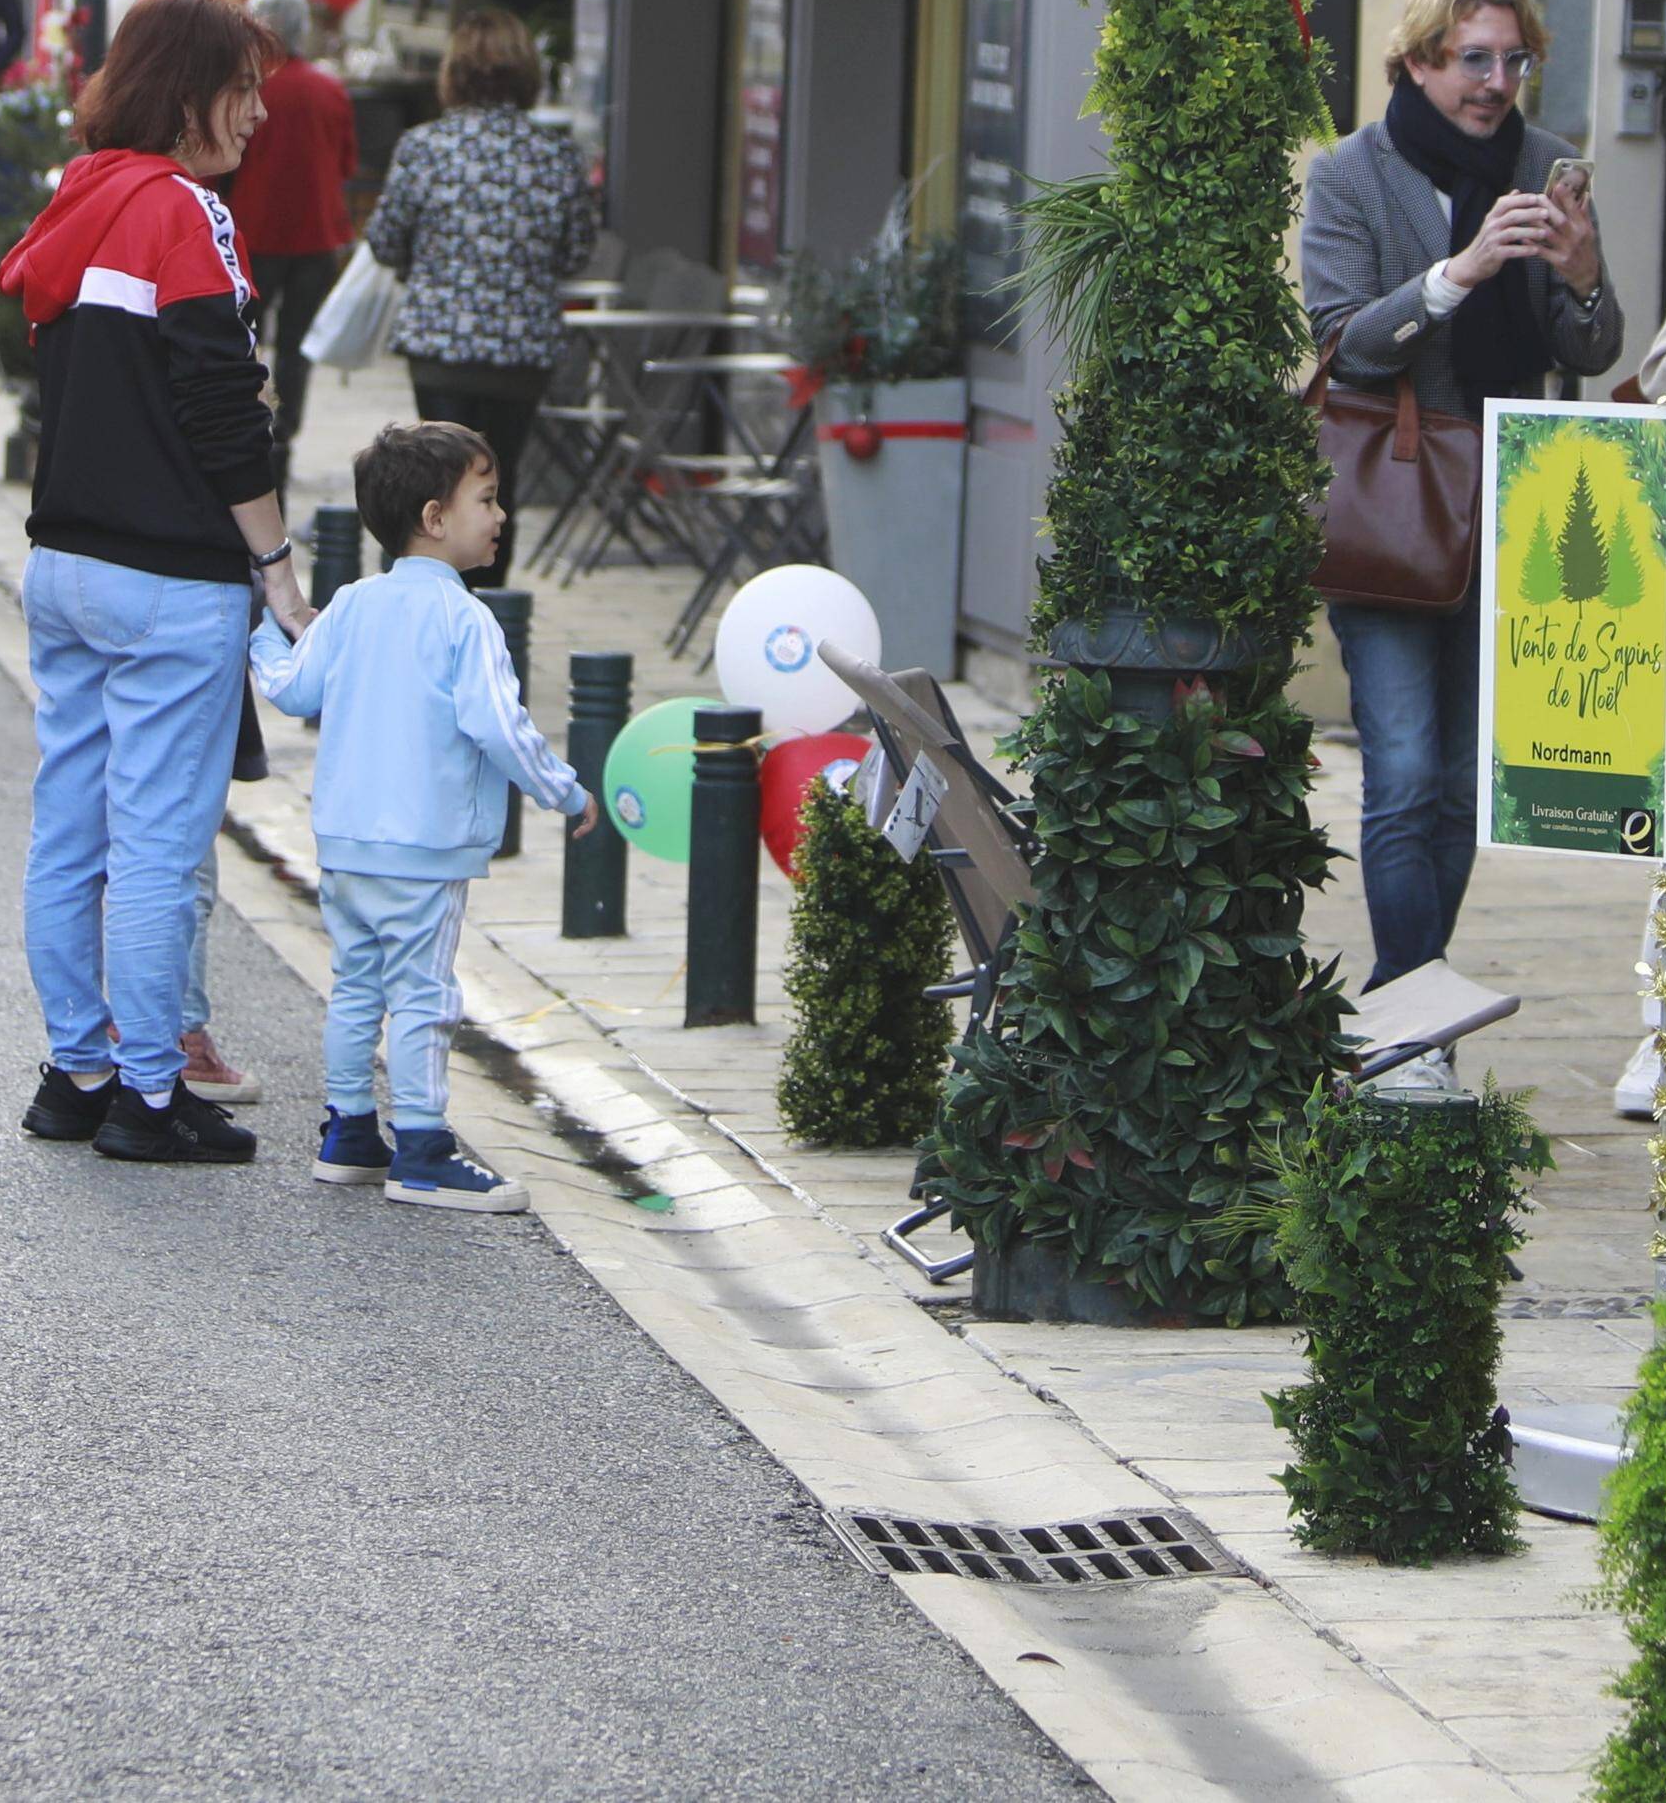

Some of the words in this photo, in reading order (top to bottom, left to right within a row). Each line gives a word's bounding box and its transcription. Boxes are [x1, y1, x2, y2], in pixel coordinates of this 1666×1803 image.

[1510, 615, 1561, 668] Vente
[1565, 620, 1589, 662] de
[1596, 621, 1663, 687] Sapins
[1547, 666, 1571, 708] de
[1578, 668, 1624, 719] Noël
[1531, 741, 1612, 766] Nordmann
[1531, 803, 1574, 820] Livraison
